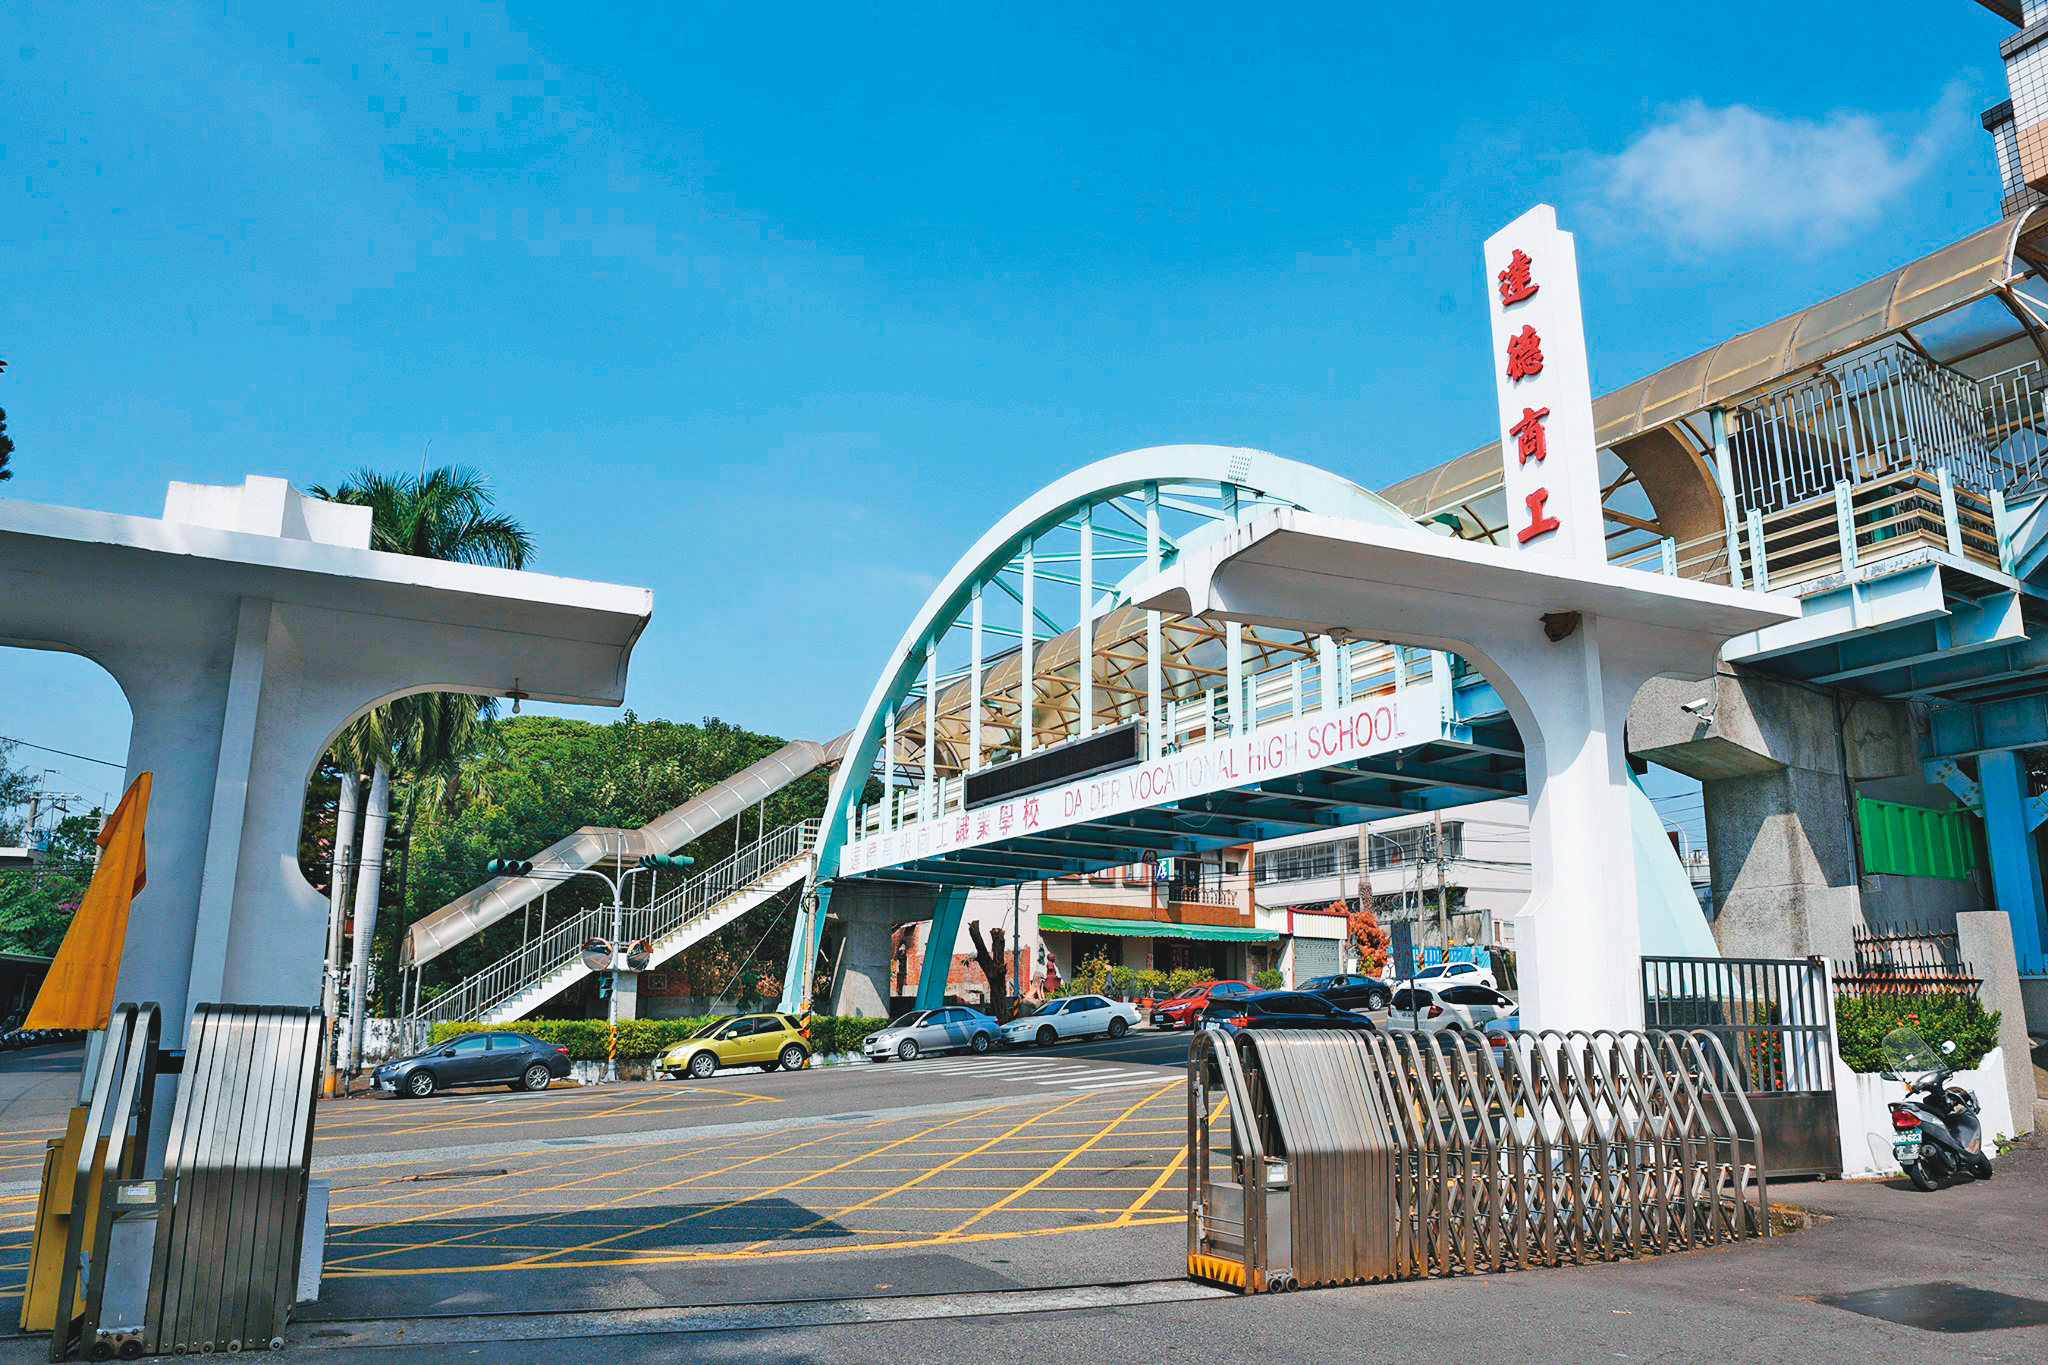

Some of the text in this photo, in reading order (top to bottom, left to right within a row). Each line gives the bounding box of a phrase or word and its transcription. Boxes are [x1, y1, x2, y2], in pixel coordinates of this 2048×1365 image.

[1498, 249, 1560, 544] 達德商工
[1064, 702, 1408, 817] DA DER VOCATIONAL HIGH SCHOOL
